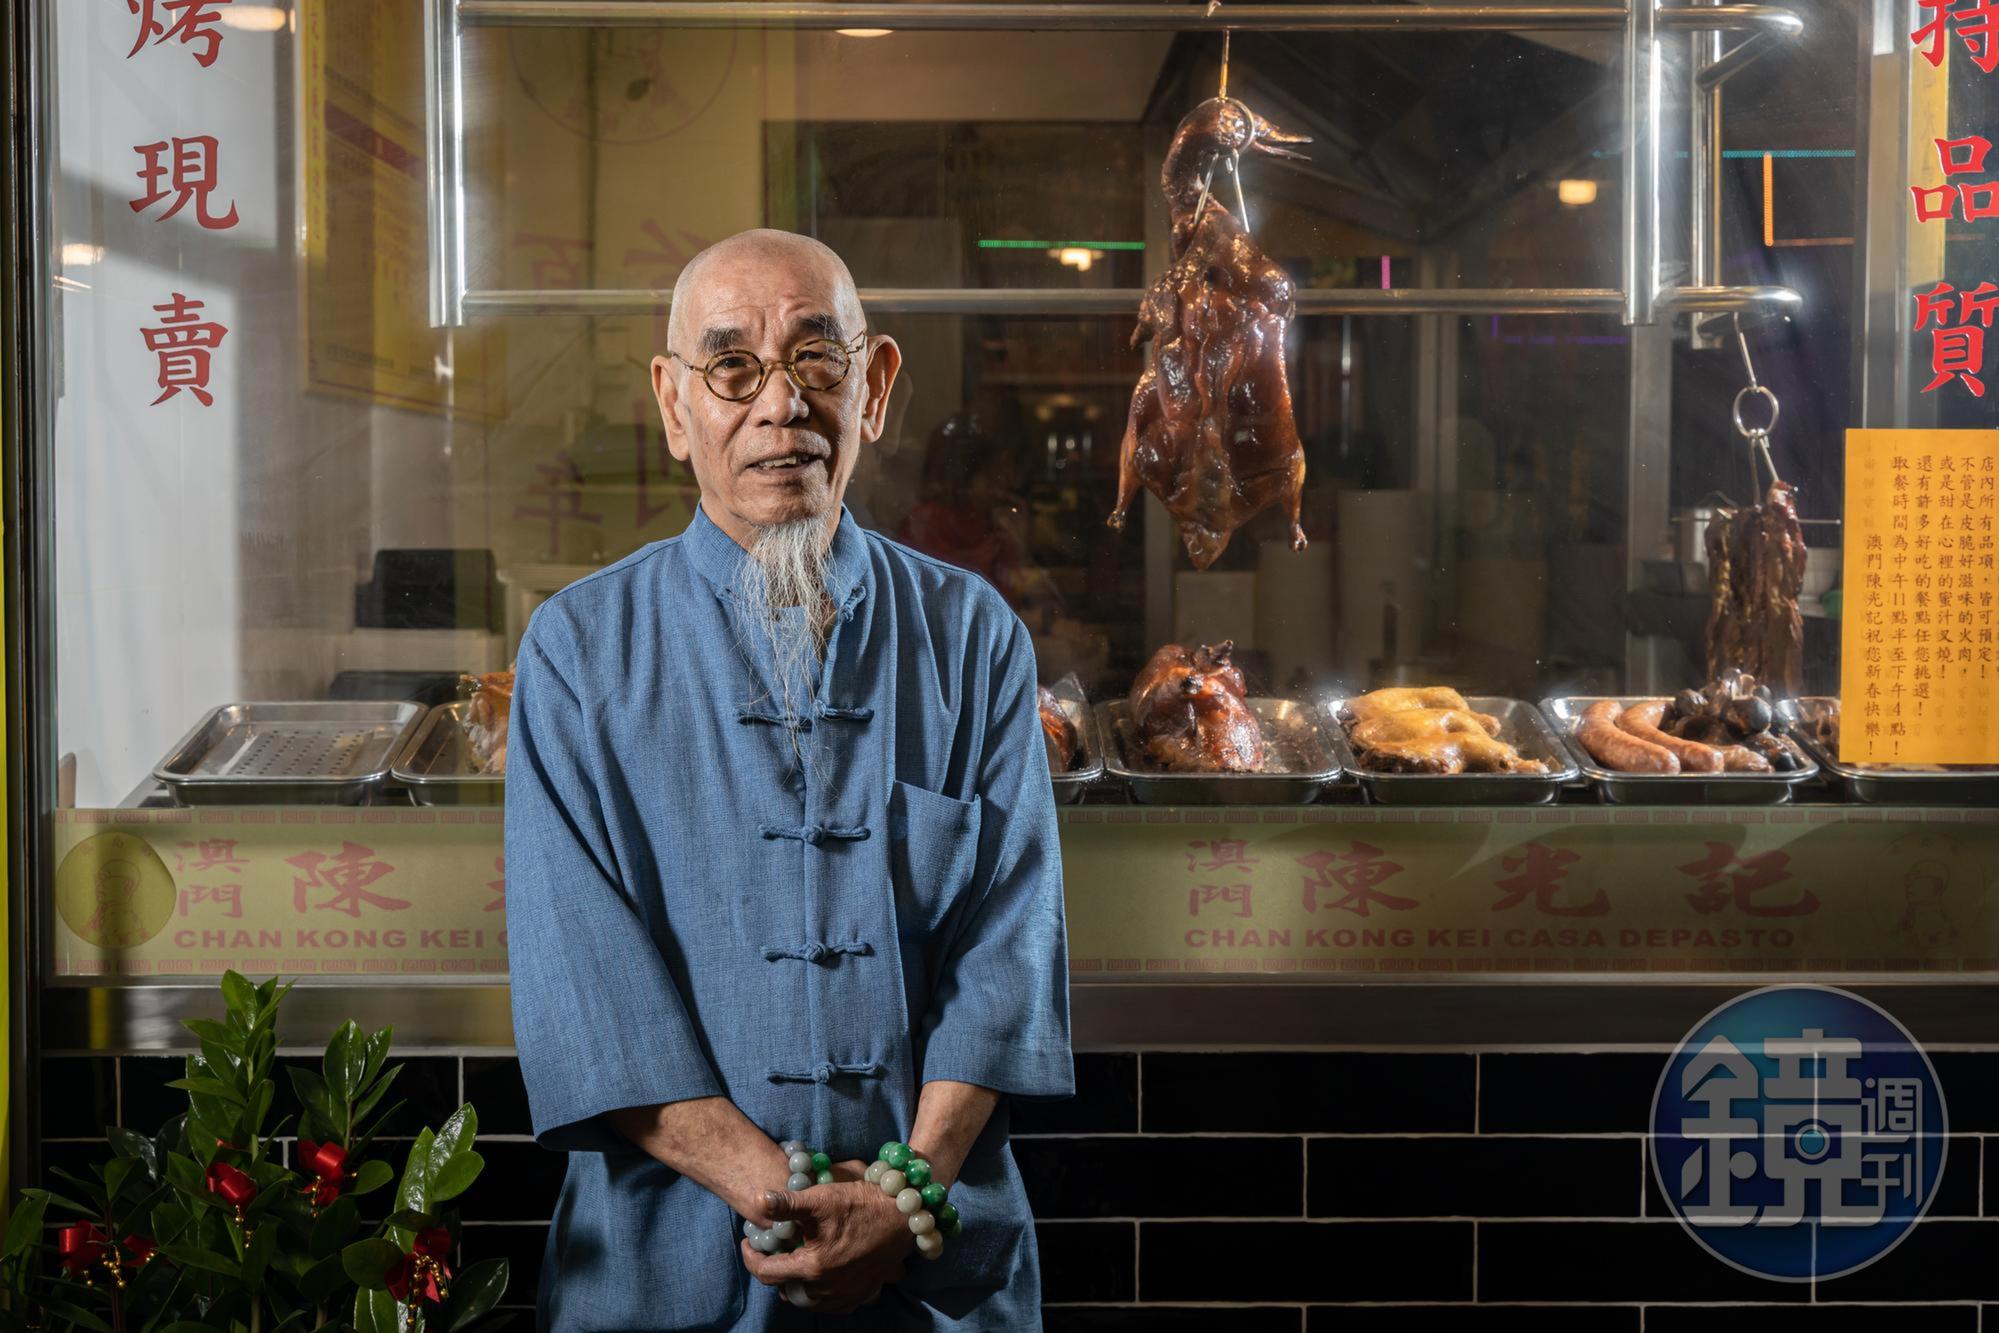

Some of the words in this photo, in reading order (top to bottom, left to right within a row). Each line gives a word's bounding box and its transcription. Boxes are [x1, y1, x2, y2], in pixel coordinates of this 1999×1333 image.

[174, 837, 250, 918] 澳門
[1185, 839, 1260, 918] 澳門
[1296, 841, 1821, 918] 陳光記
[174, 929, 283, 948] CHAN
[297, 929, 406, 948] KONG
[420, 929, 484, 948] KEI
[1185, 929, 1292, 948] CHAN
[1305, 929, 1415, 948] KONG
[1428, 929, 1490, 948] KEI
[1504, 928, 1606, 948] CASA
[1619, 928, 1795, 948] DEPASTO
